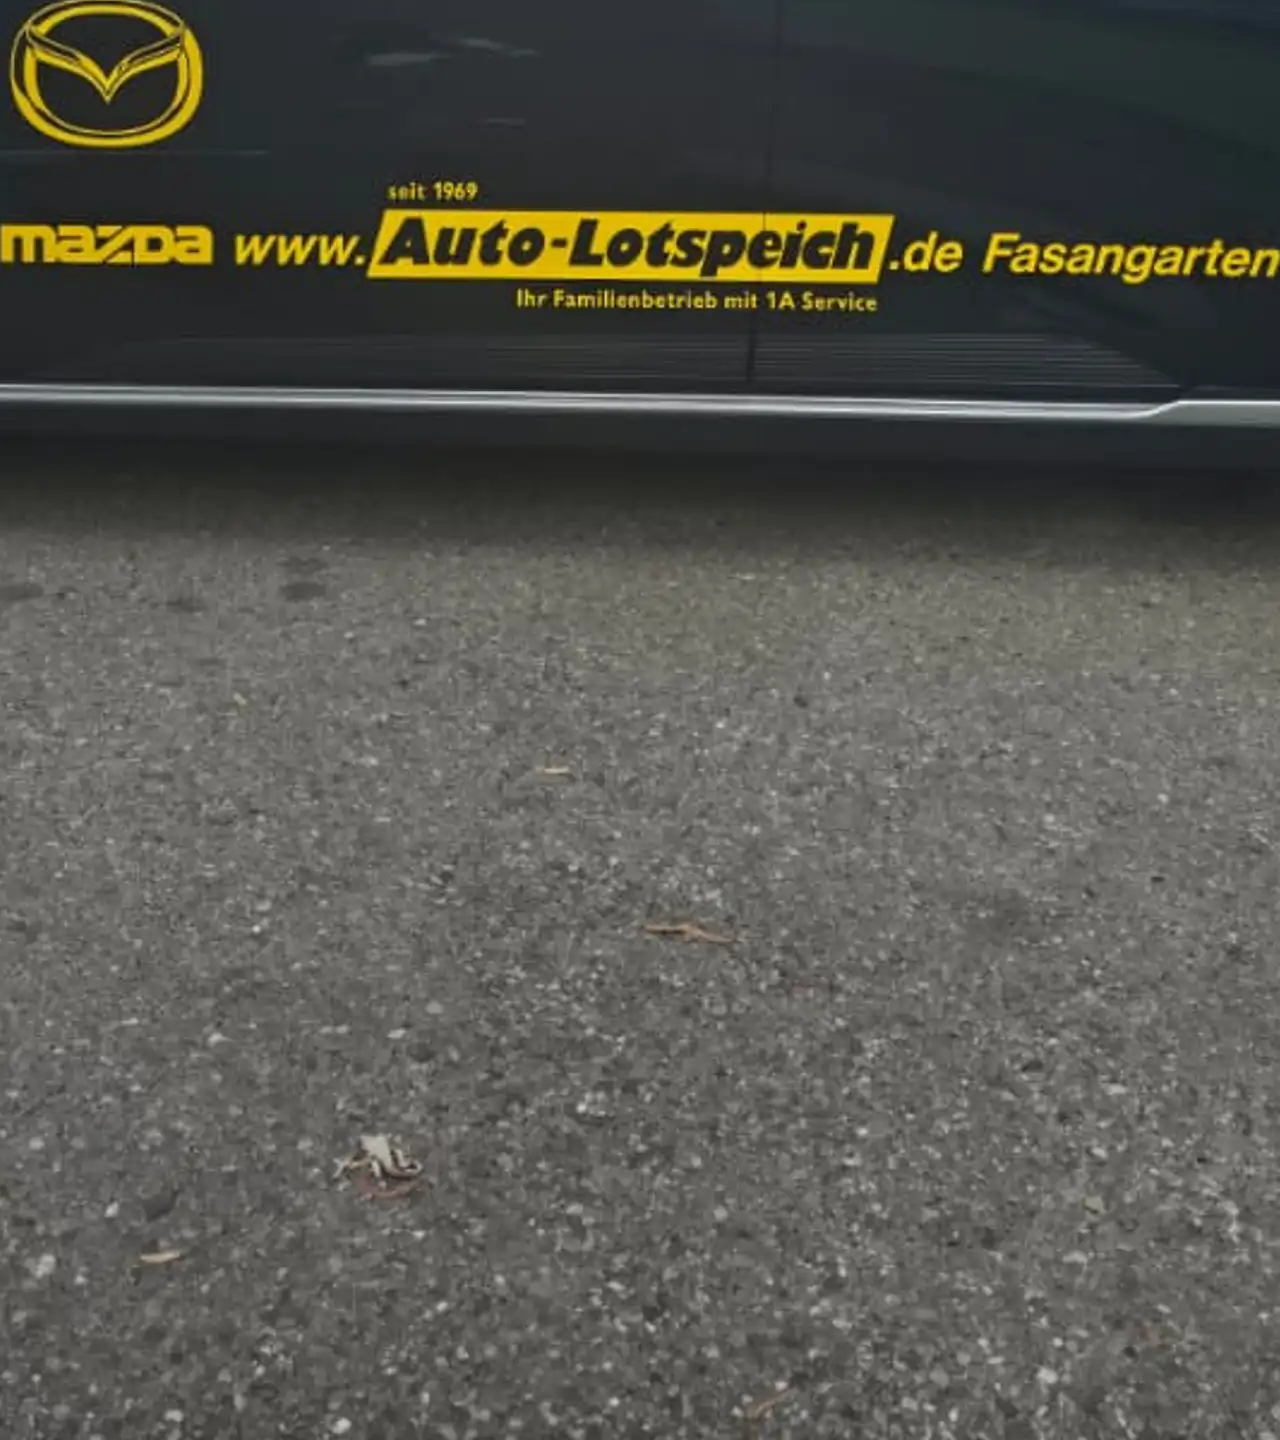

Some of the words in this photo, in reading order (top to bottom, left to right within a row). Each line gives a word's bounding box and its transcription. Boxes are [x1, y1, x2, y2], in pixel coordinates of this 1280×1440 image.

[387, 182, 425, 200] seit
[434, 181, 478, 200] 1969
[516, 288, 548, 308] Ihr
[553, 289, 718, 310] Familienbetrieb
[723, 291, 758, 310] mit
[766, 292, 796, 310] 1A
[801, 292, 878, 312] Service
